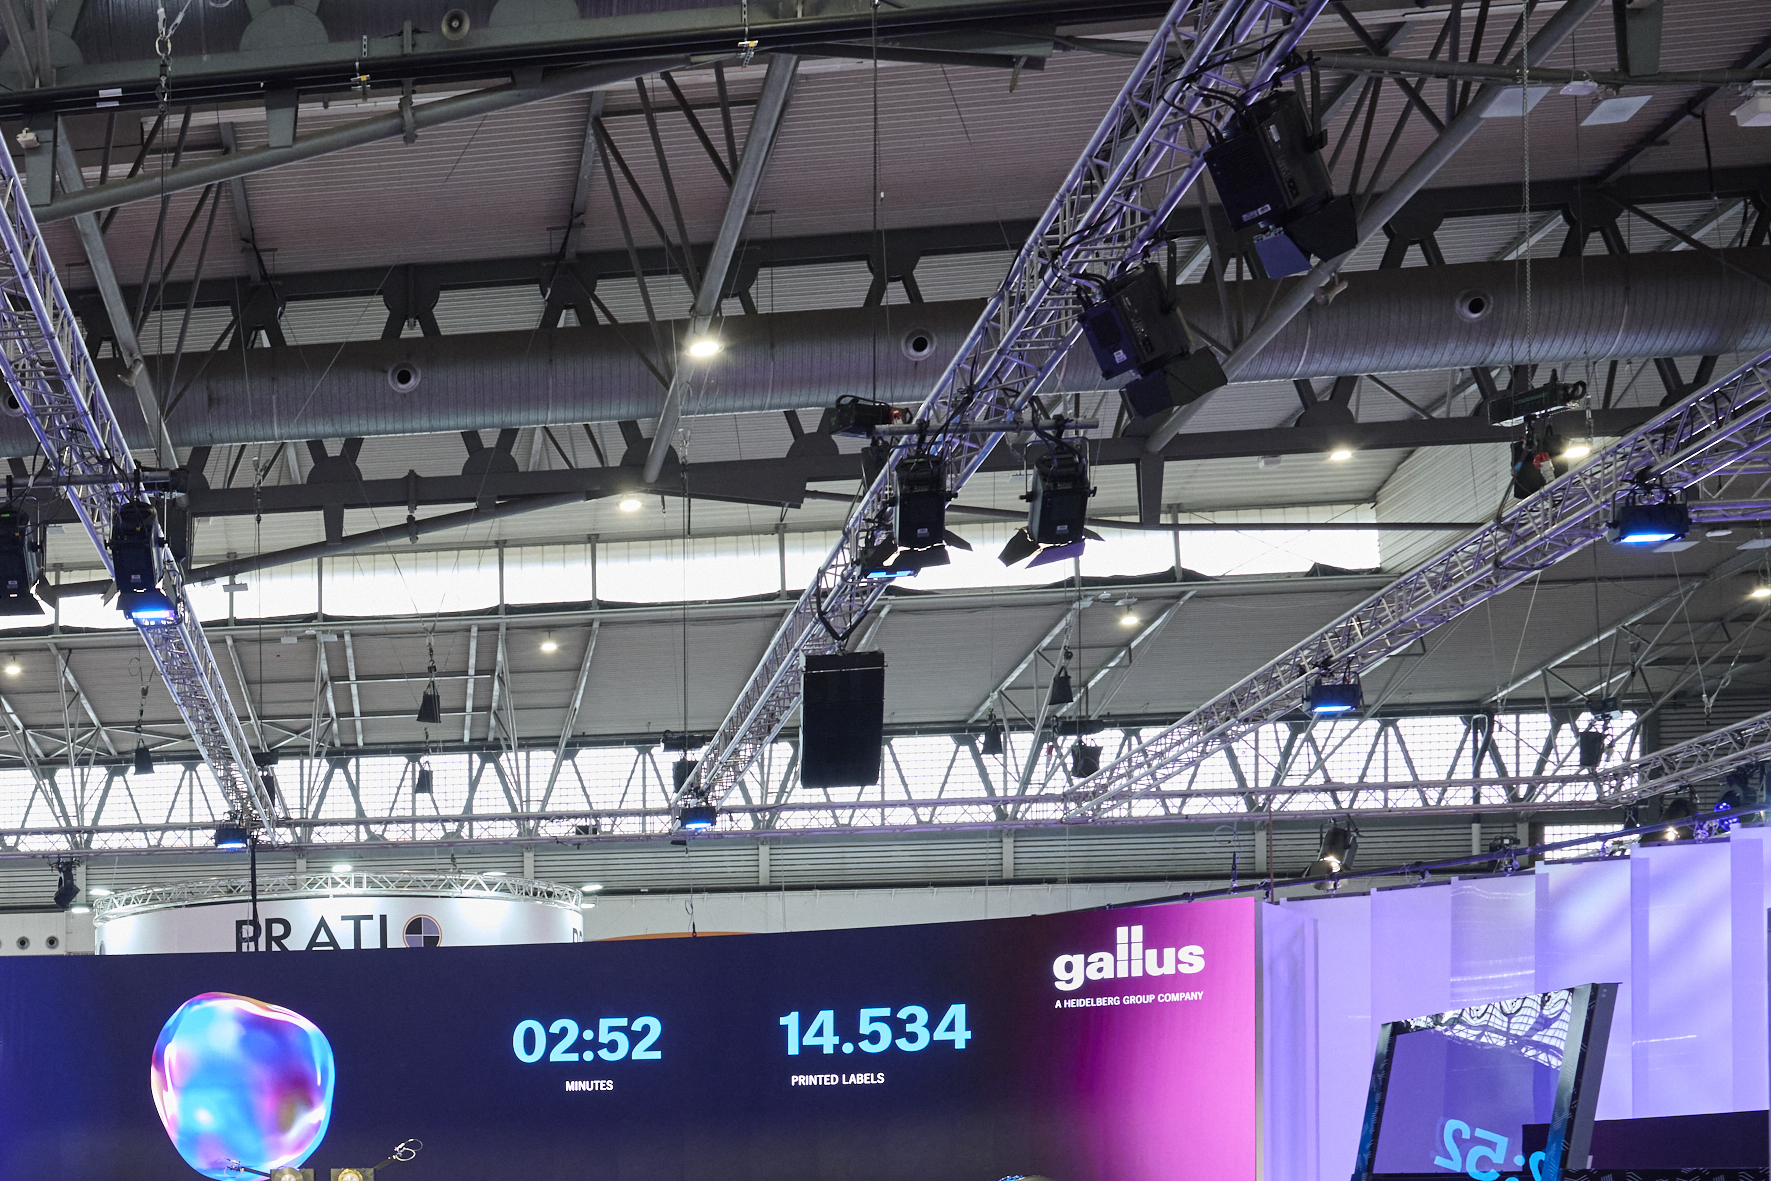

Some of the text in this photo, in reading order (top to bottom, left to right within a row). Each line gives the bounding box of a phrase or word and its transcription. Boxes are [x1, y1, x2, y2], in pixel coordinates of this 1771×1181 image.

[235, 914, 388, 952] PRATI
[1052, 924, 1206, 992] gallus
[1054, 991, 1205, 1009] A HEIDELBERG GROUP COMPANY
[512, 1016, 663, 1064] 02:52
[778, 1003, 972, 1056] 14.534
[565, 1079, 615, 1092] MINUTES
[790, 1072, 885, 1088] PRINTED LABELS
